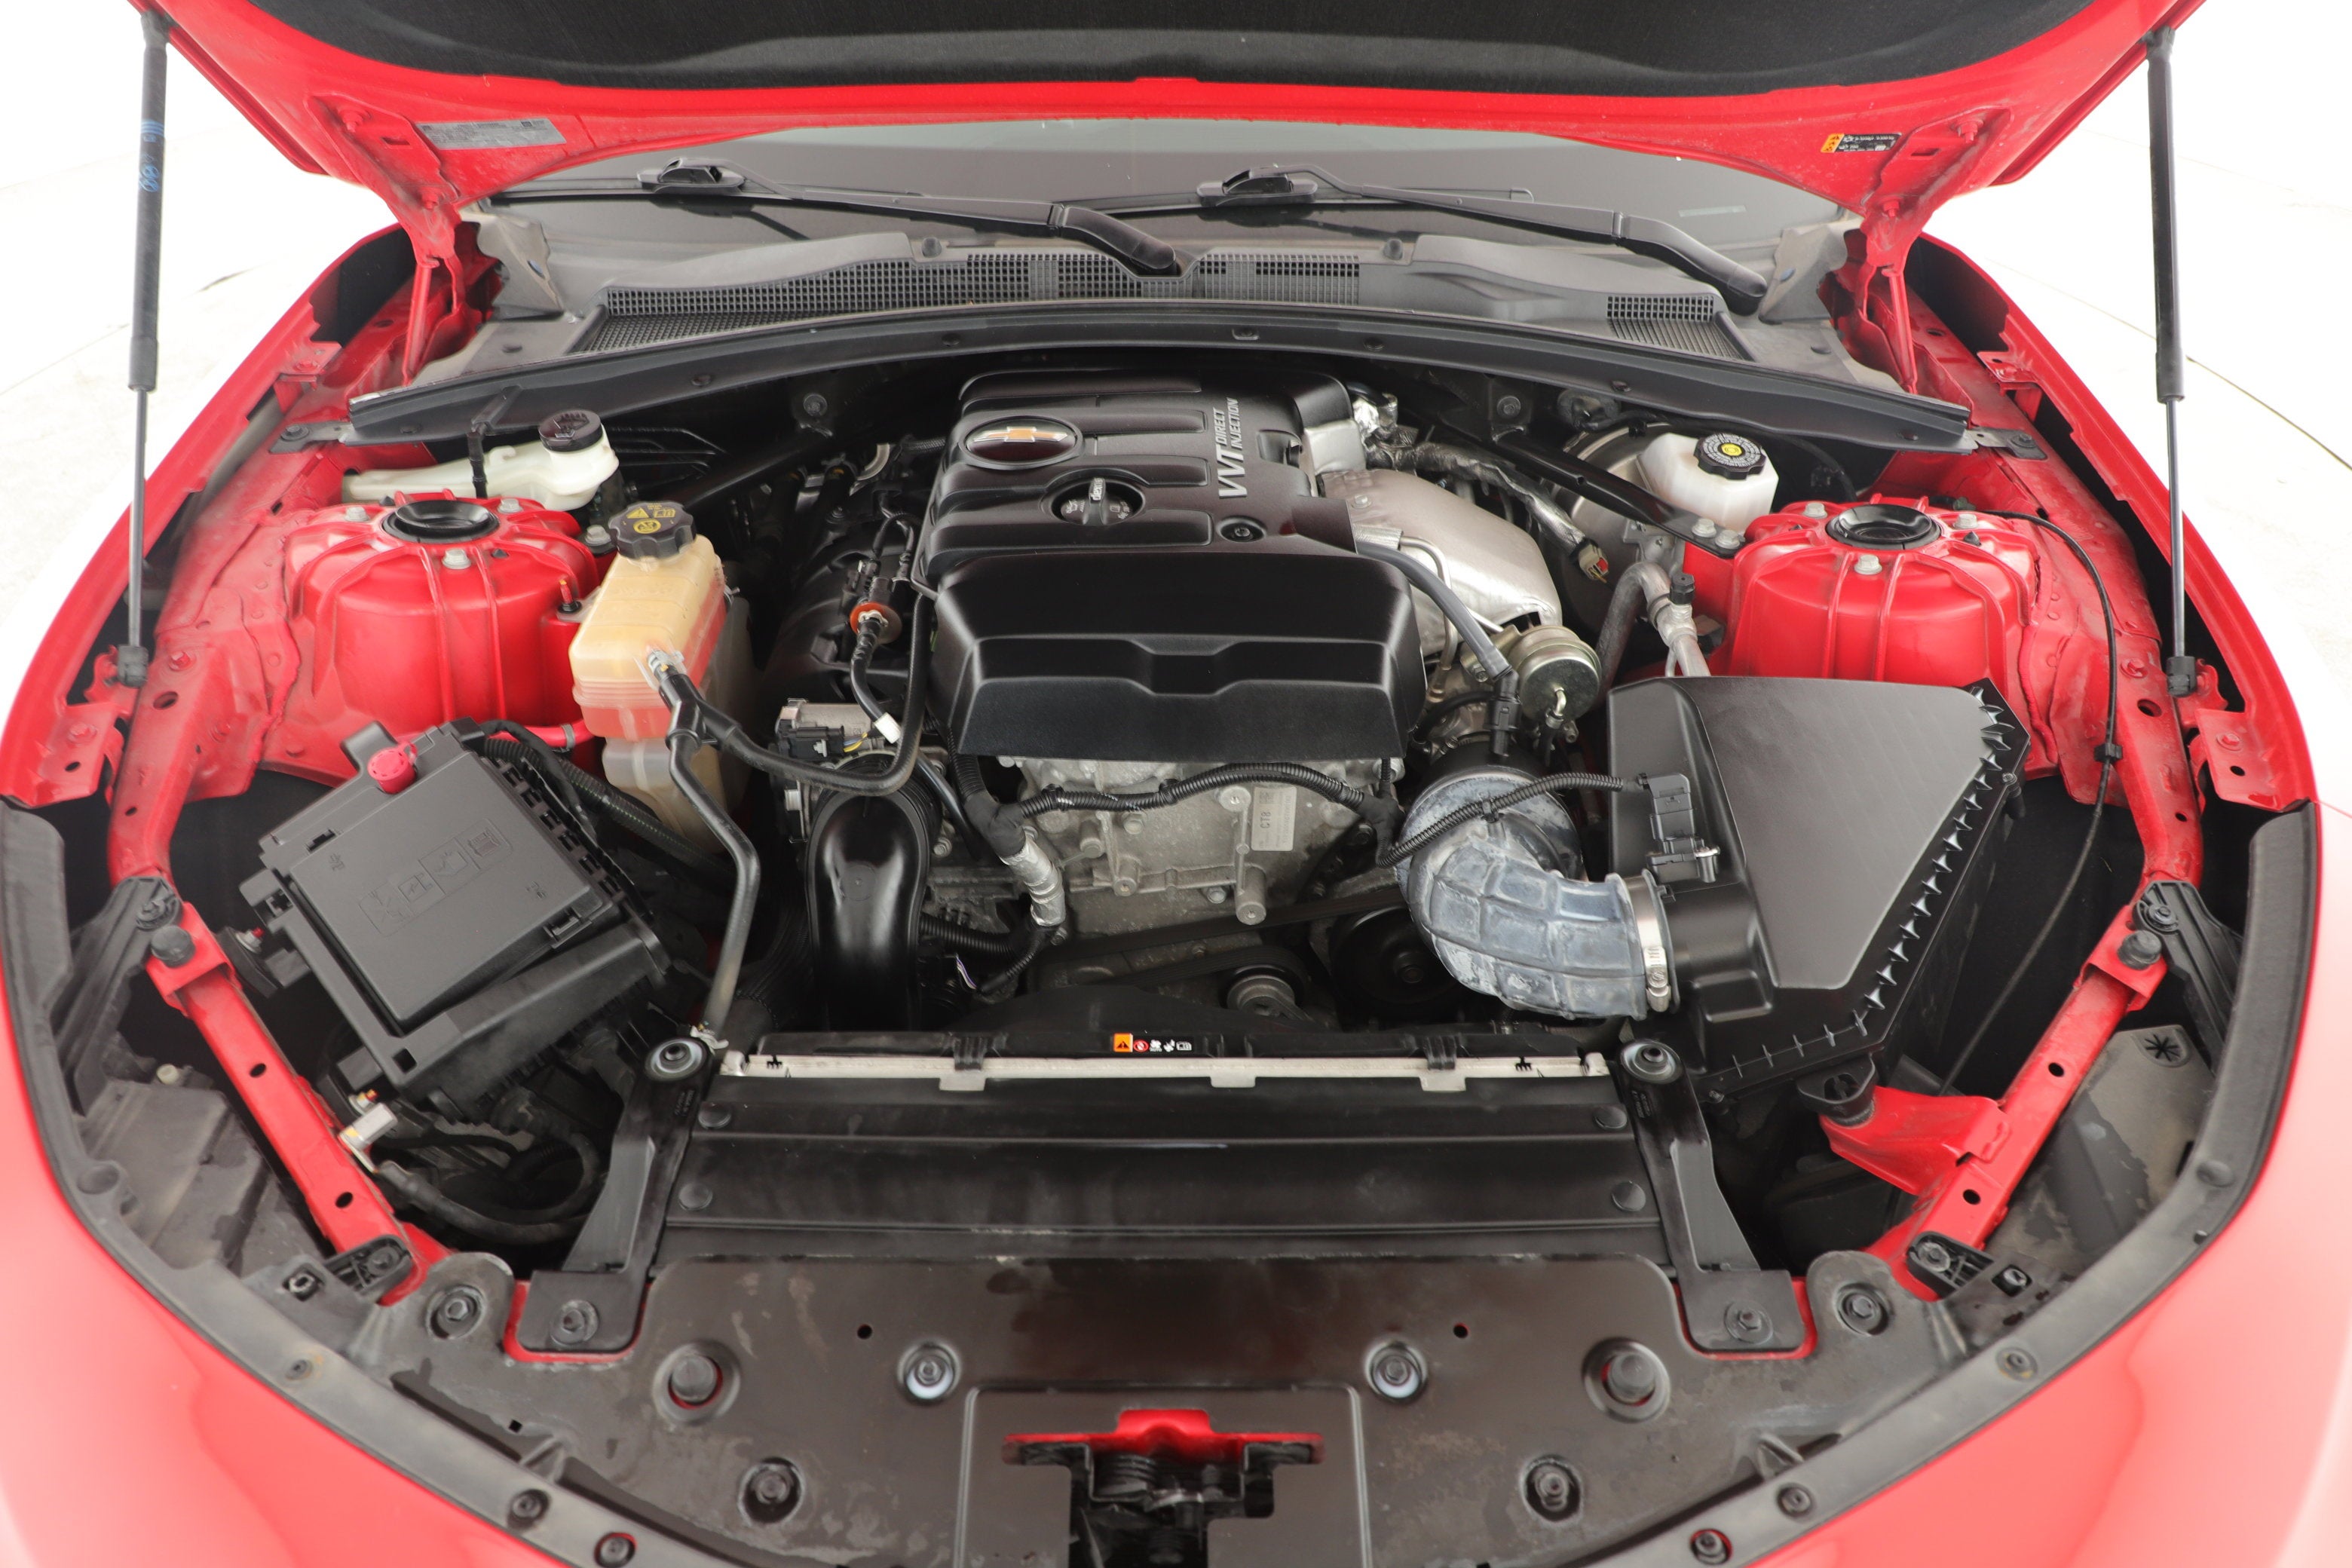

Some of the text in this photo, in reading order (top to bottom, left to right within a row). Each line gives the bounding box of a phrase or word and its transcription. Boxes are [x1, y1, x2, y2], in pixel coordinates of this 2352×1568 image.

[1213, 407, 1227, 446] DIRECT
[1227, 397, 1242, 449] INJECTION
[1216, 443, 1247, 498] VVT
[1260, 811, 1271, 829] CT8
